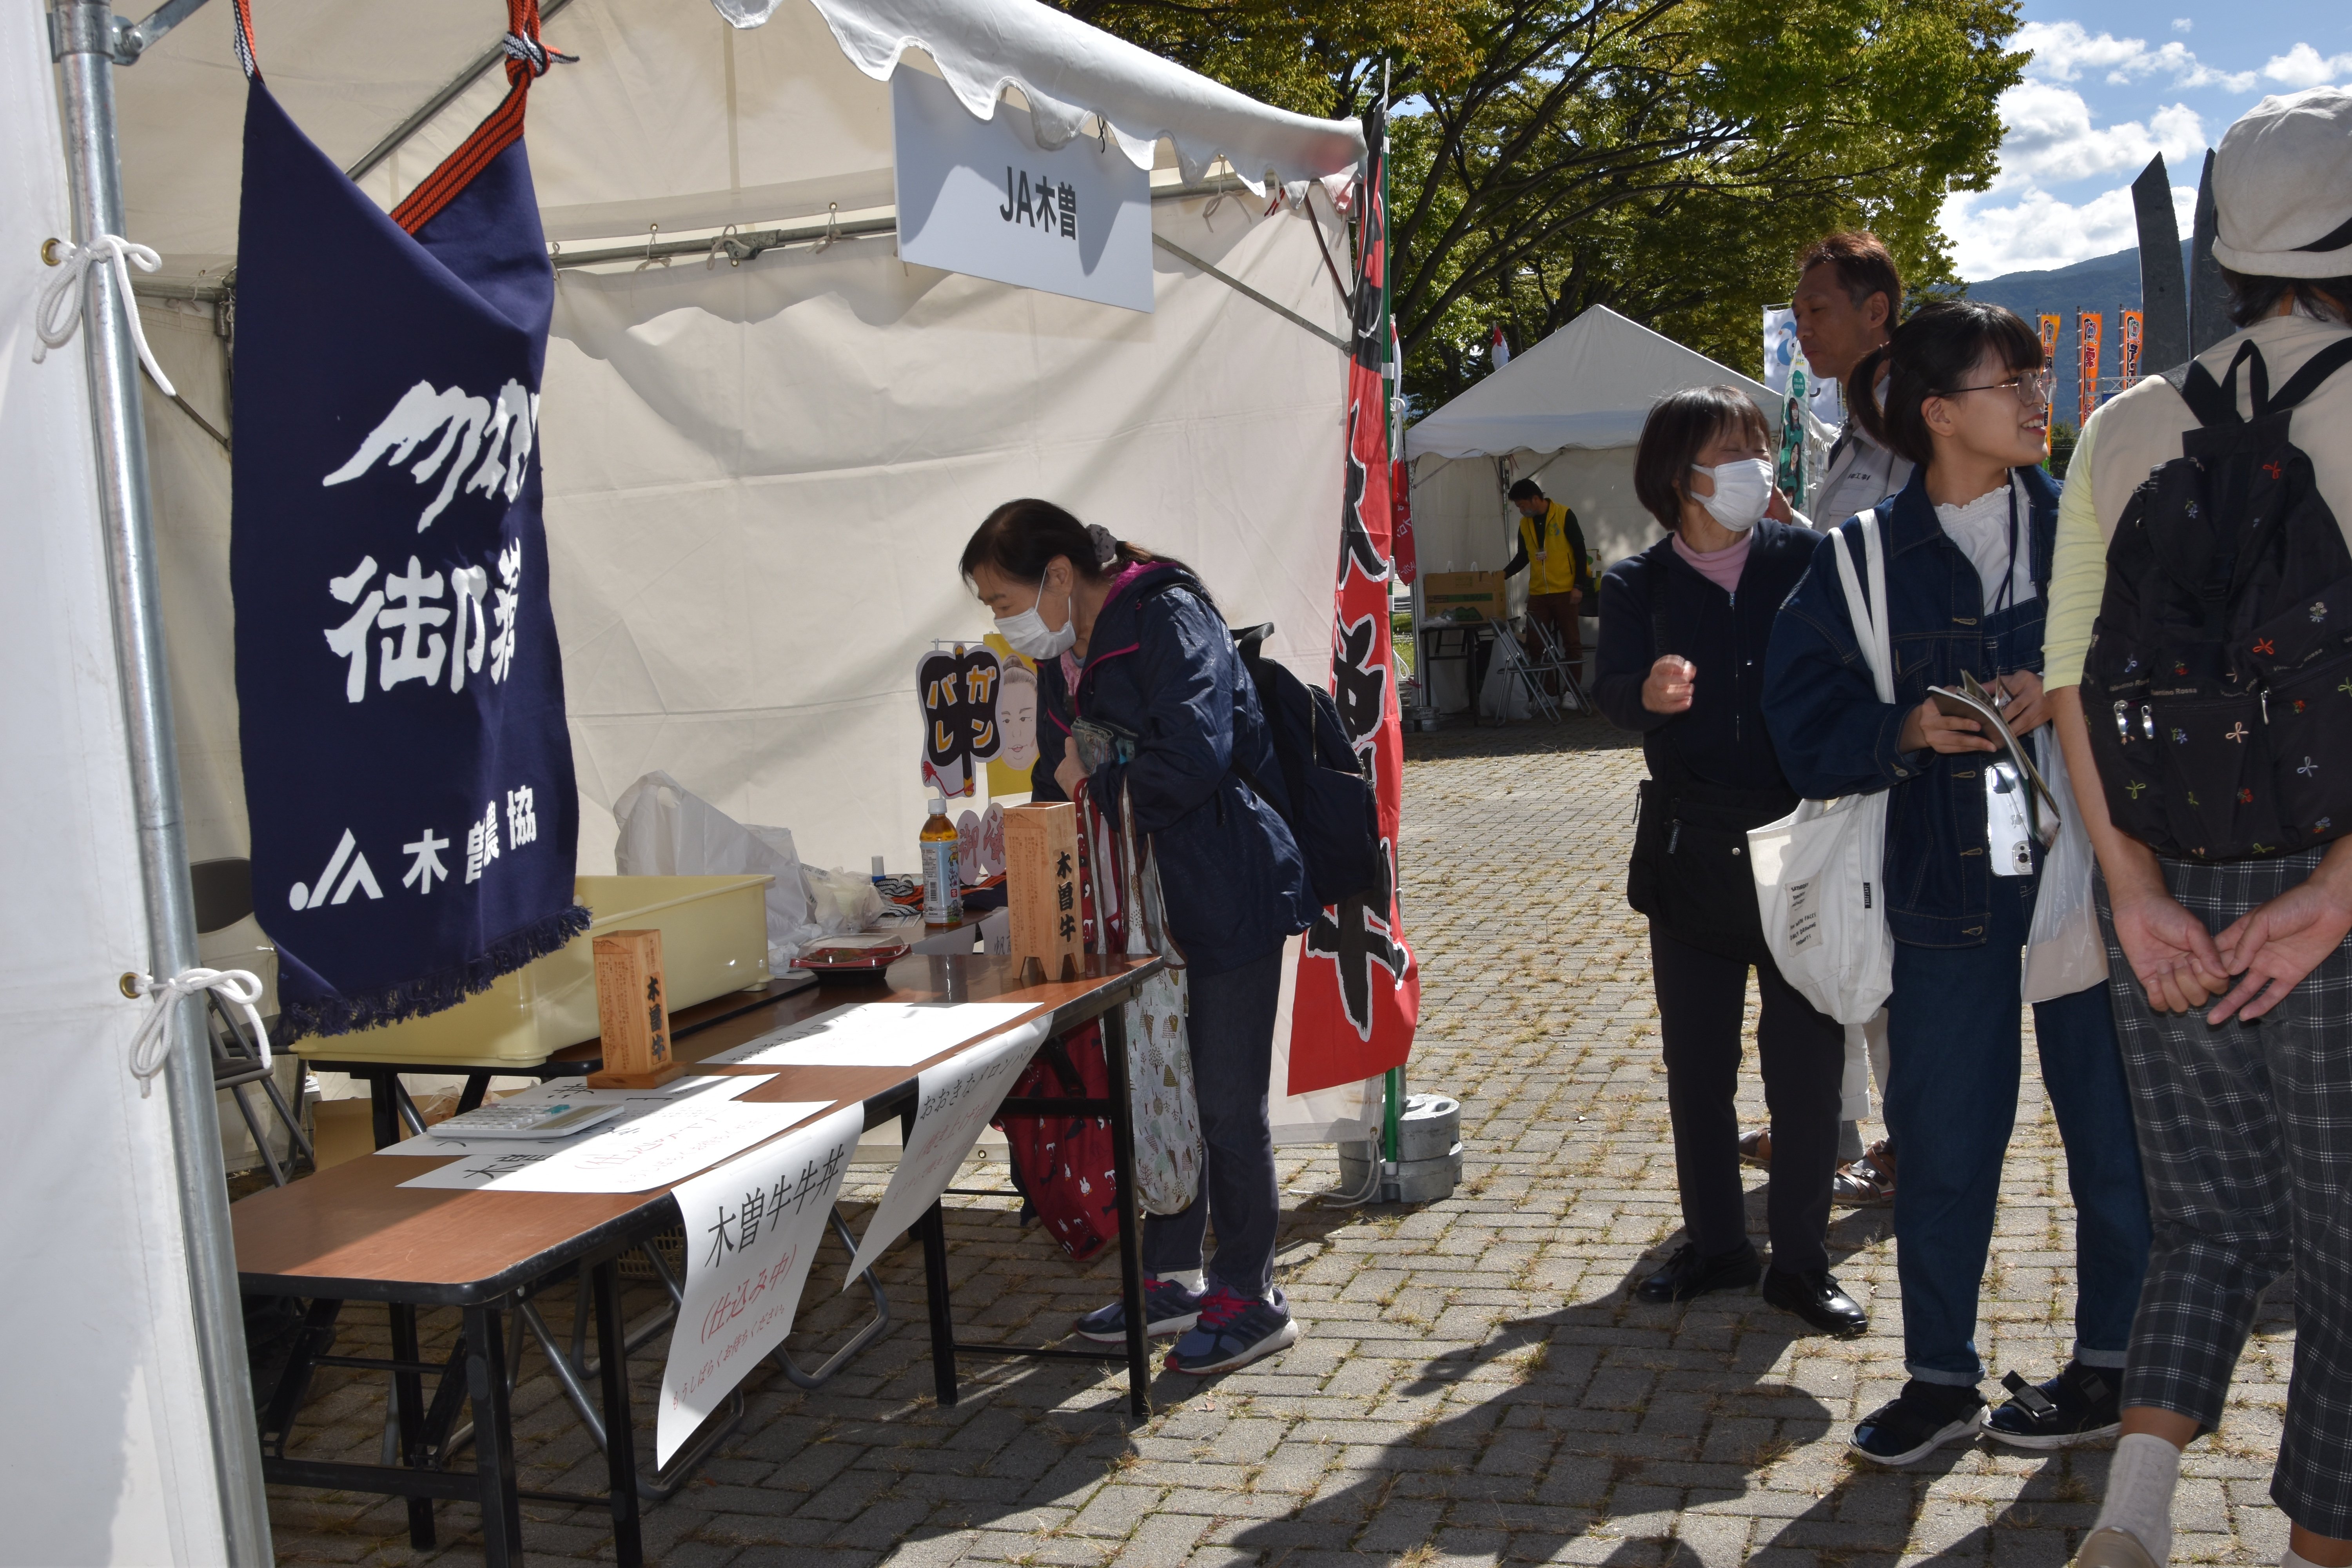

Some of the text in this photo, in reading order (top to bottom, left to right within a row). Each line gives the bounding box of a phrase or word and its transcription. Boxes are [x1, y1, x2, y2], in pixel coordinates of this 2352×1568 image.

[1000, 166, 1076, 240] JA木曽
[927, 673, 957, 753] バレ
[966, 665, 997, 748] ガン
[1056, 851, 1076, 942] 木曽牛
[1800, 922, 1816, 935] DRAWING
[1804, 912, 1816, 921] FACES
[647, 976, 666, 1061] 木曽牛
[920, 1043, 1038, 1120] おおきなメロンパン
[704, 1143, 844, 1268] 木曽牛牛丼
[701, 1244, 797, 1344] (仕込み中)
[673, 1304, 785, 1410] もうしばらくお待ちください。
